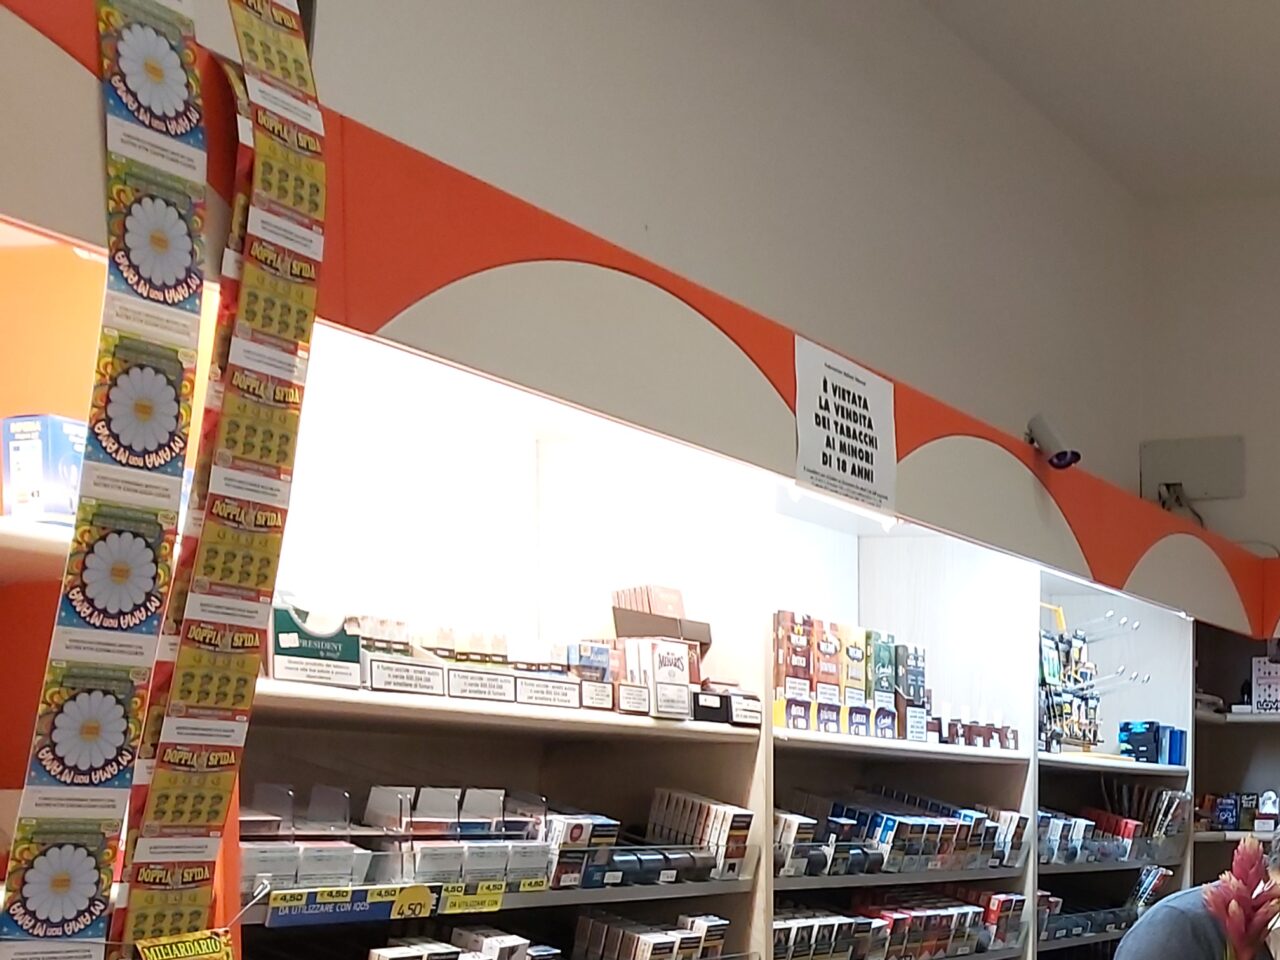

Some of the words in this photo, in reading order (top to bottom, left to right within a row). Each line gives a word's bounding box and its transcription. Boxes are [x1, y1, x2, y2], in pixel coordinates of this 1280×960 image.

[832, 383, 869, 411] VIETATA
[819, 396, 830, 414] LA
[834, 402, 873, 431] VENDITA
[815, 413, 830, 432] DEI
[834, 421, 878, 450] TABACCHI
[826, 435, 836, 451] AI
[839, 440, 874, 465] MINORI
[822, 452, 832, 468] DI
[837, 457, 847, 473] 18
[851, 466, 874, 484] ANNI
[213, 501, 245, 521] DOPPIA
[256, 510, 282, 526] SFIDA
[188, 625, 221, 645] DOPPIA
[232, 632, 260, 648] SFIDA
[92, 751, 133, 784] M'AMA
[163, 749, 197, 764] DOPPIA
[209, 751, 236, 766] SFIDA
[138, 866, 172, 883] DOPPIA
[183, 865, 210, 882] SFIDA
[64, 900, 105, 934] M'AMA
[336, 903, 350, 912] CON
